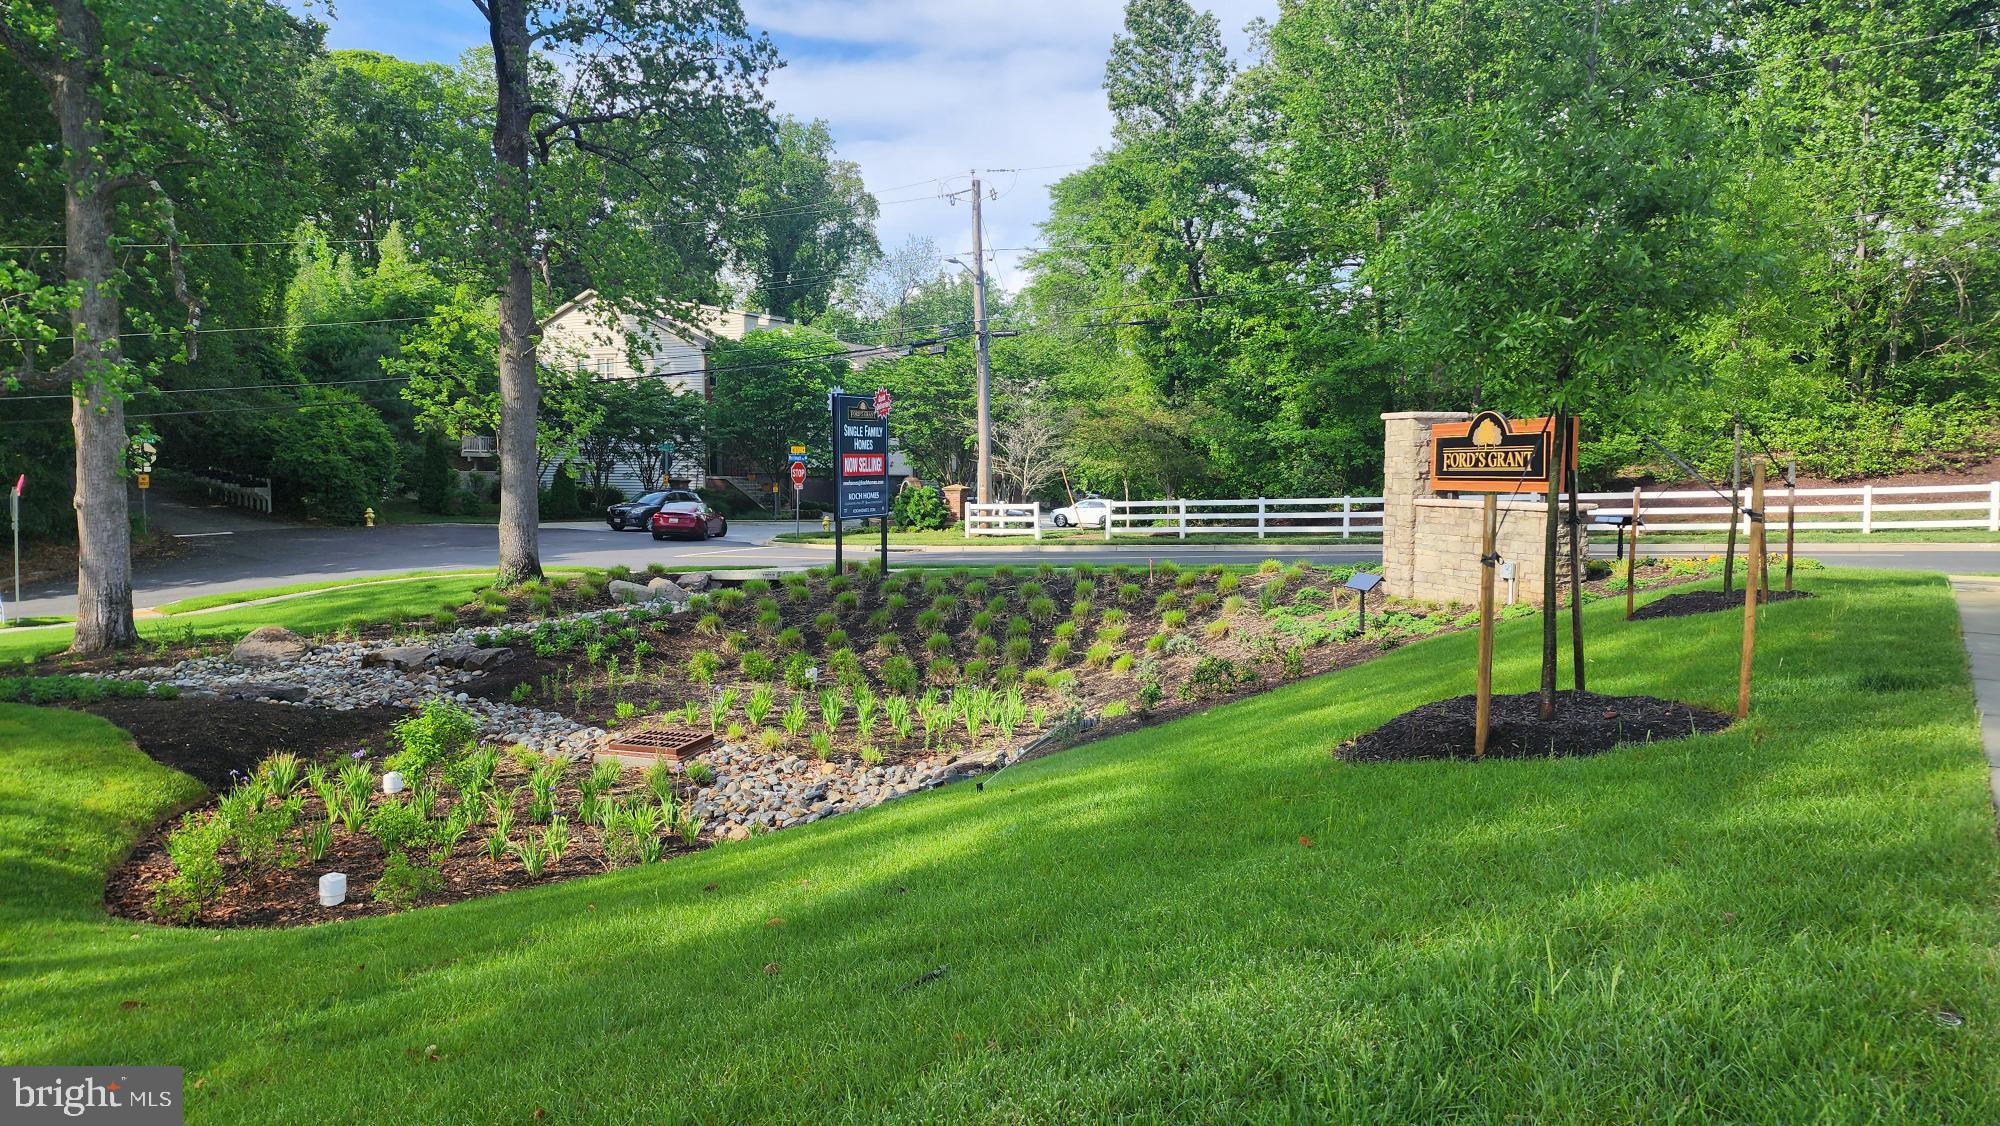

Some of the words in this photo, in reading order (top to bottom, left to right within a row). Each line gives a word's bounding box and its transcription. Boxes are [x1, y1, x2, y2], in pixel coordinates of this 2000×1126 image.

[843, 424, 864, 437] SINGLE
[864, 425, 884, 438] FAMILY
[854, 438, 873, 450] HOMES
[844, 457, 858, 473] NOW
[858, 457, 882, 472] SELLING!
[1442, 452, 1486, 471] FORD'S
[1487, 451, 1532, 471] GRANT
[792, 469, 805, 477] STOP
[862, 491, 880, 500] HOMES
